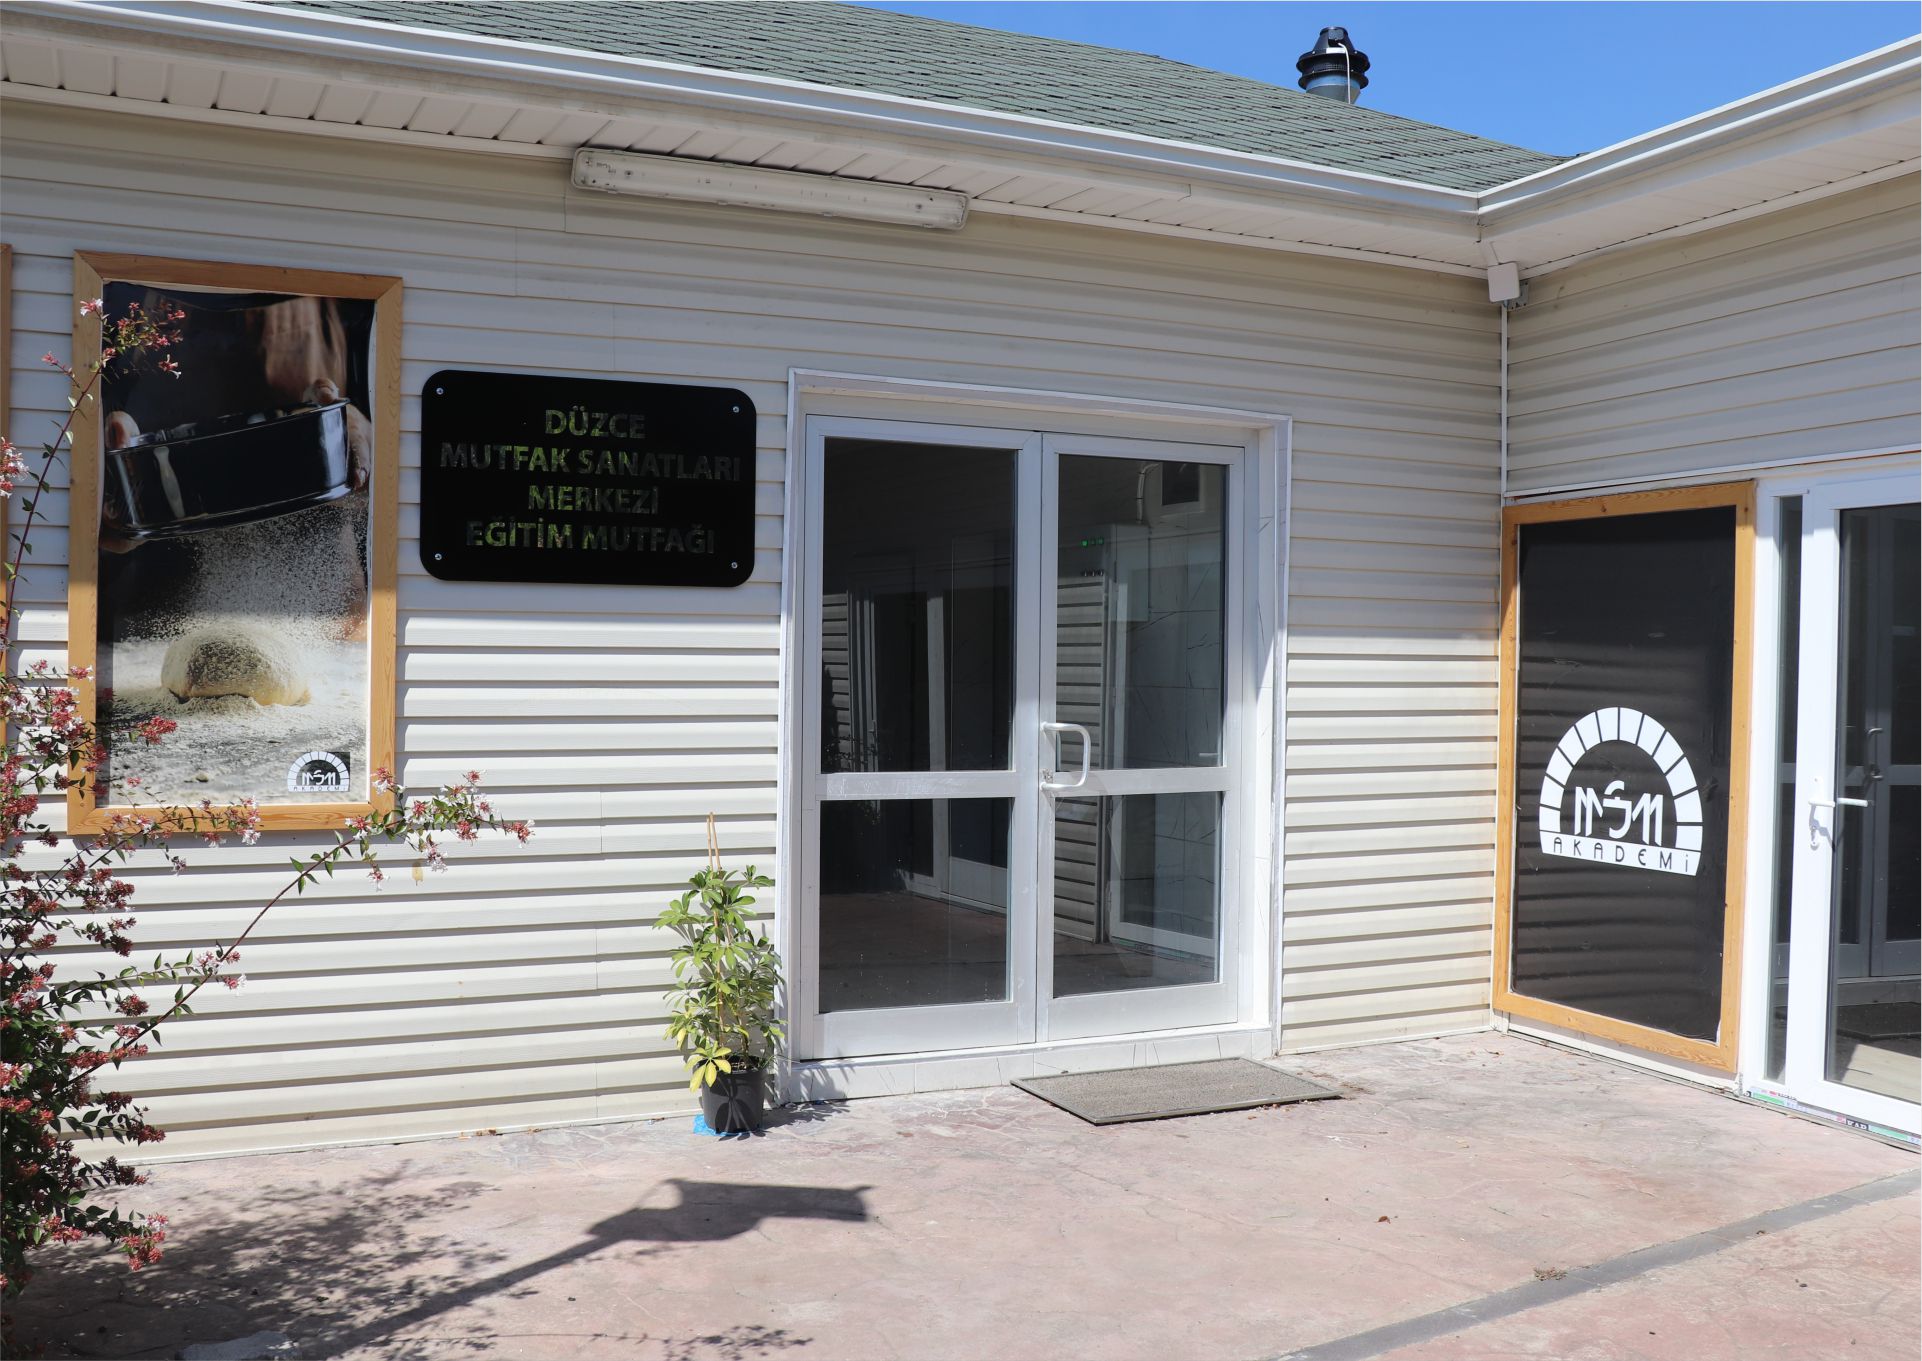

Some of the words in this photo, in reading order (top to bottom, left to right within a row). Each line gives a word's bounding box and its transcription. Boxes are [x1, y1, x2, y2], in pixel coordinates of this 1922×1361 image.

[544, 405, 646, 439] DÜZCE
[439, 442, 570, 473] MUTFAK
[577, 449, 741, 481] SANATLARI
[528, 485, 659, 514] MERKEZİ
[465, 516, 574, 549] EĞİTİM
[580, 523, 715, 554] MUTFAĞI
[1574, 780, 1664, 847] MSM
